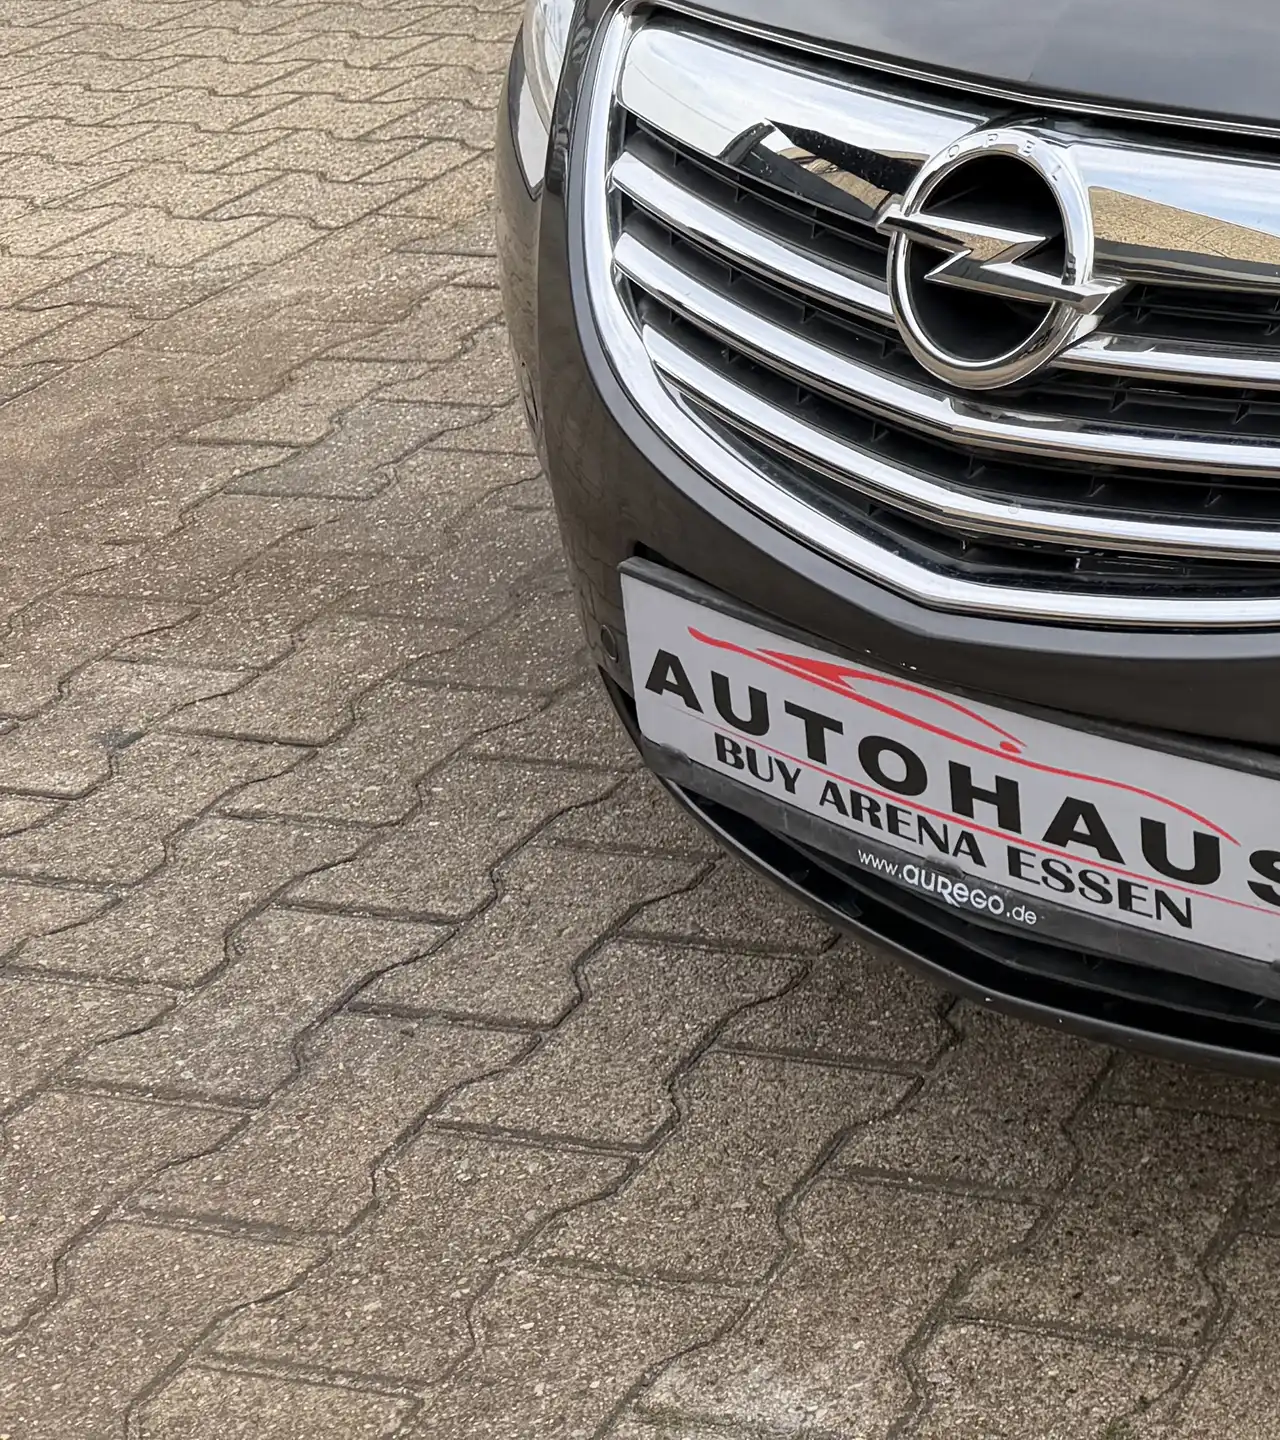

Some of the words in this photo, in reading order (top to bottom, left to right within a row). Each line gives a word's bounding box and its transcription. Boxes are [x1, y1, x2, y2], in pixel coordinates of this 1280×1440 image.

[948, 133, 1062, 182] OPEL
[715, 732, 801, 794] BUY
[819, 780, 986, 868] ARENA
[1007, 845, 1192, 929] ESSEN
